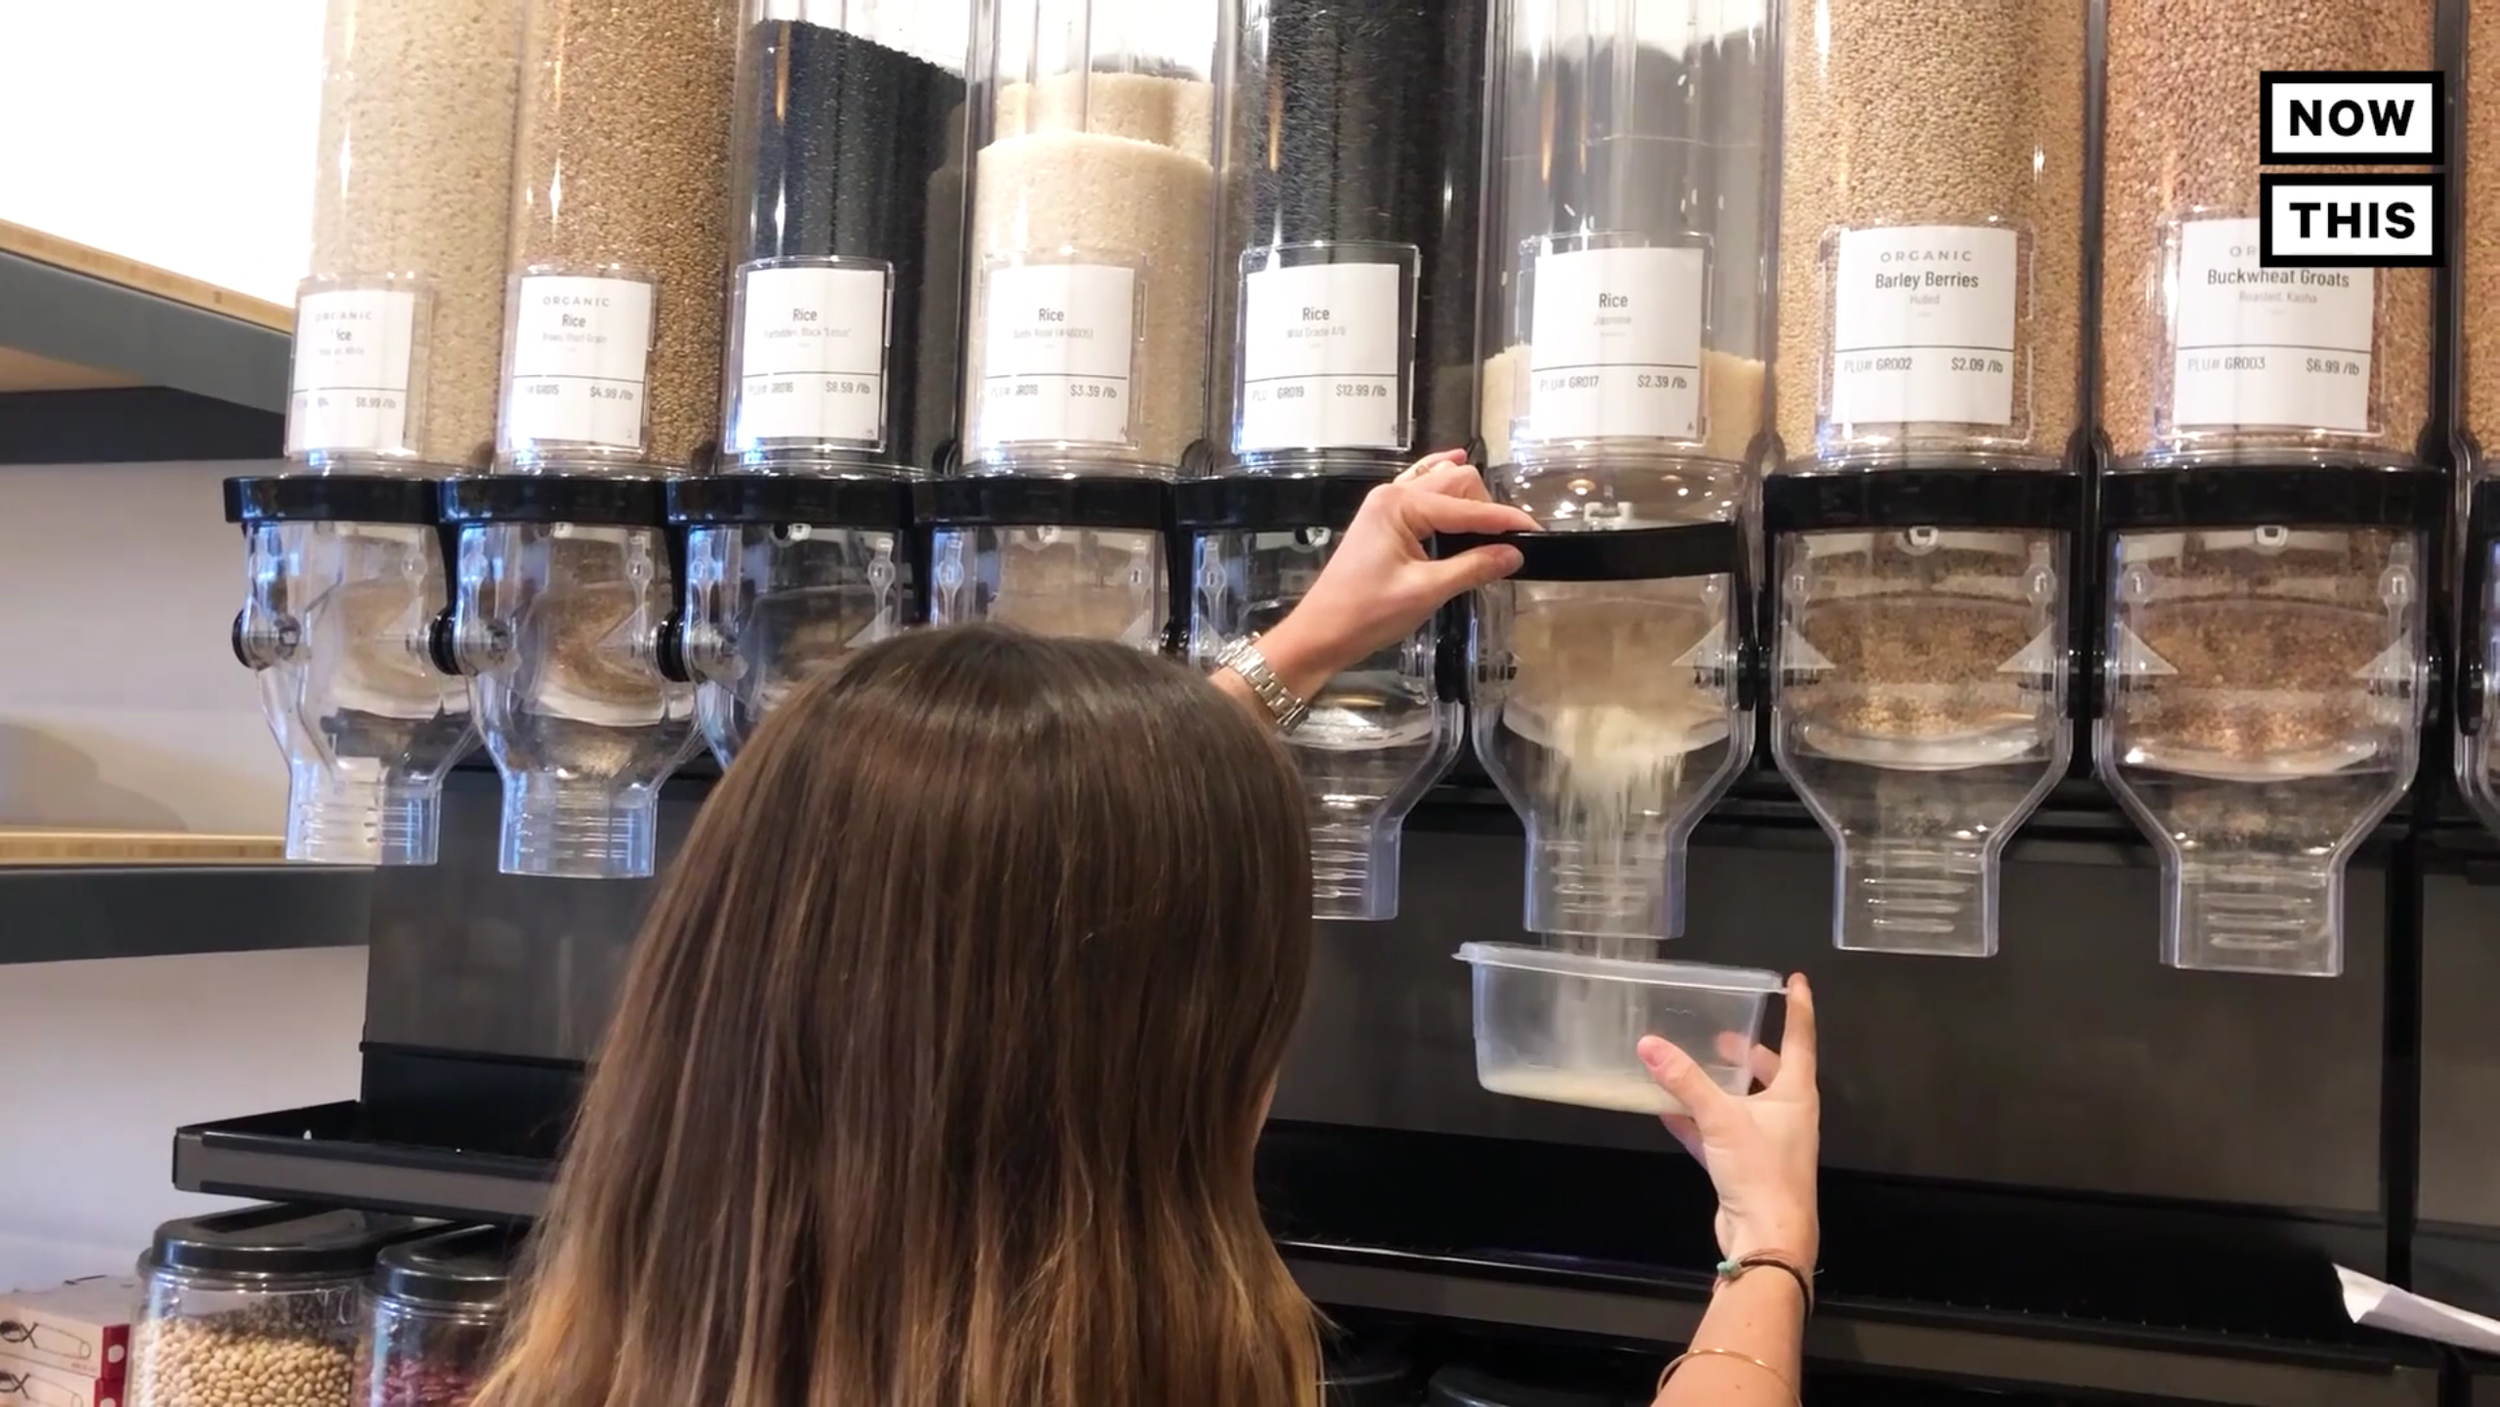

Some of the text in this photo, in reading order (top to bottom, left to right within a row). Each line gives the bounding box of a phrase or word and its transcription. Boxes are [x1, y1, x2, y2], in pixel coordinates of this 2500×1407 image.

[1880, 249, 1973, 263] ORGANIC
[1875, 271, 1979, 290] Barley Berries
[2207, 268, 2350, 287] Buckwheat Groats
[543, 296, 610, 307] ORGANIC
[1599, 293, 1628, 308] Rice
[562, 313, 586, 328] Rice
[793, 308, 817, 322] Rice
[1038, 308, 1064, 322] Rice
[1302, 307, 1330, 321] Rice
[1305, 326, 1329, 338] Grade
[1844, 356, 2004, 374] PLU# GR002 $2.09 /lb
[2187, 356, 2360, 376] PLU# GR003 $6.99 /lb
[855, 382, 871, 395] /lb
[1070, 383, 1100, 398] $3.39
[1102, 386, 1118, 398] /lb
[1539, 375, 1687, 392] PLU# GR017 $2.39 /lb
[589, 386, 617, 399] $4.99
[618, 389, 634, 401] /lb
[1277, 385, 1305, 399] GR019
[1335, 384, 1369, 398] $12.99
[1371, 384, 1387, 397] /lb
